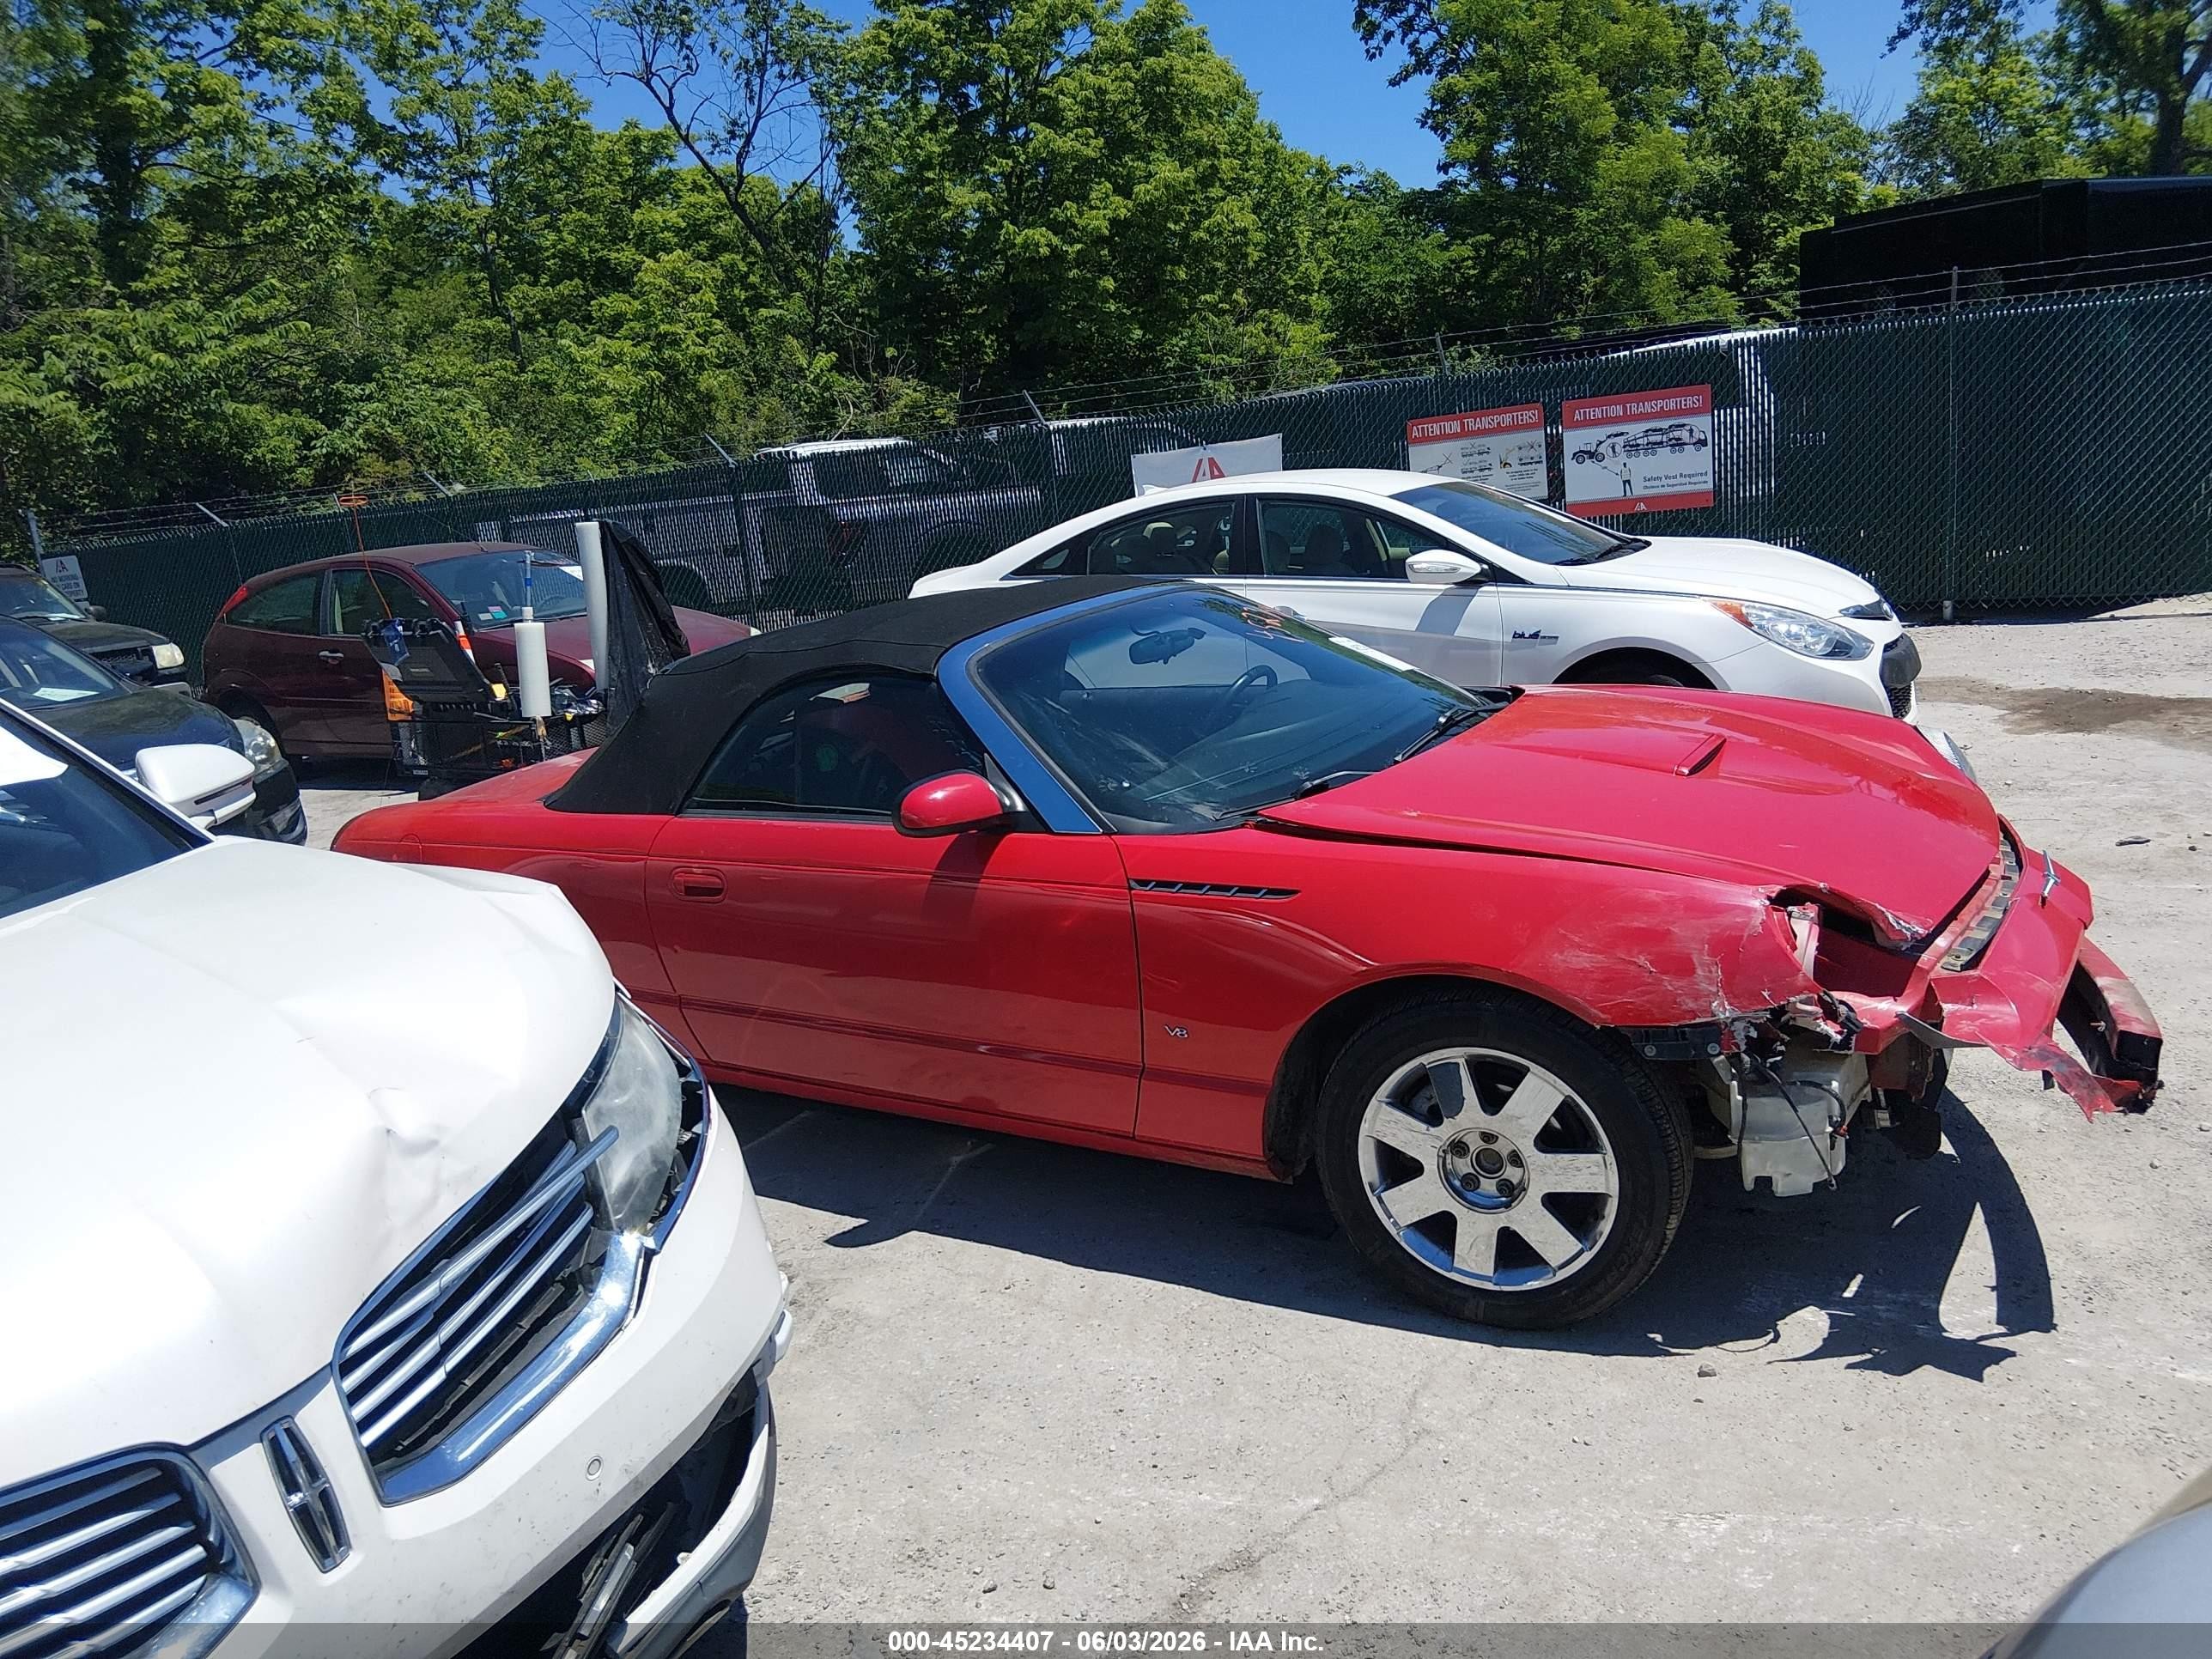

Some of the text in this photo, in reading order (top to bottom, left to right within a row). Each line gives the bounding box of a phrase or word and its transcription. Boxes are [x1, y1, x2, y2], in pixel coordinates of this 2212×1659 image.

[1574, 395, 1703, 422] ATTENTION TRANSPORTERS!
[1412, 410, 1539, 439] ATTENTION TRANSPORTERS!
[1679, 470, 1708, 479] Required
[1512, 629, 1541, 640] blue
[1164, 1024, 1188, 1038] V8
